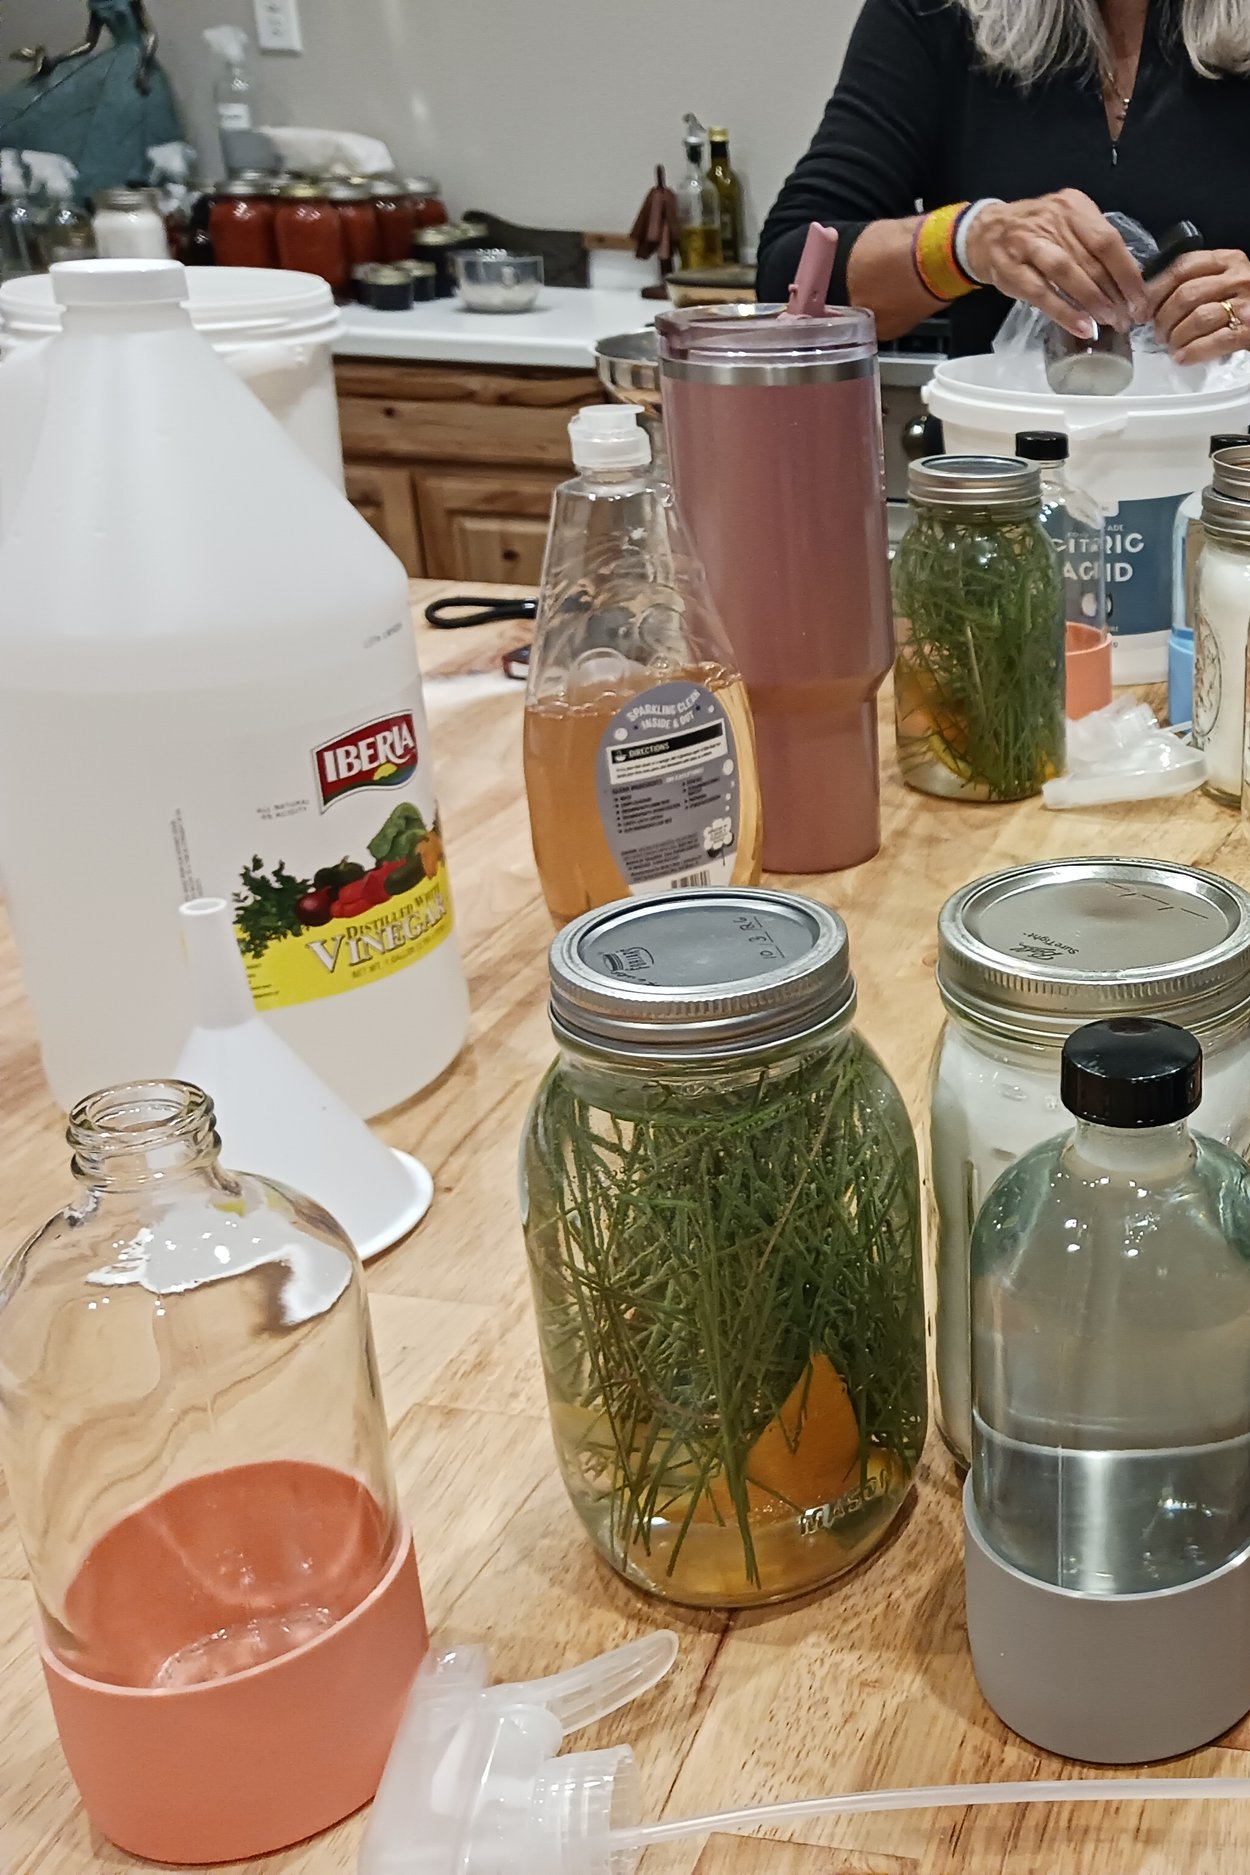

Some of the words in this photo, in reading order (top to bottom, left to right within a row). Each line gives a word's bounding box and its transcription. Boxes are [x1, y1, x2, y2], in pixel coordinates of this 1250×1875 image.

[1063, 561, 1133, 582] ACID
[627, 704, 677, 722] SPARKLING
[677, 688, 701, 713] CLEAN
[641, 717, 671, 730] INSIDE
[680, 710, 695, 725] OUT
[322, 722, 415, 783] IBERIA
[628, 741, 670, 758] DIRECTIONS
[305, 893, 447, 974] VINEGAR
[346, 903, 413, 940] DISTILLED
